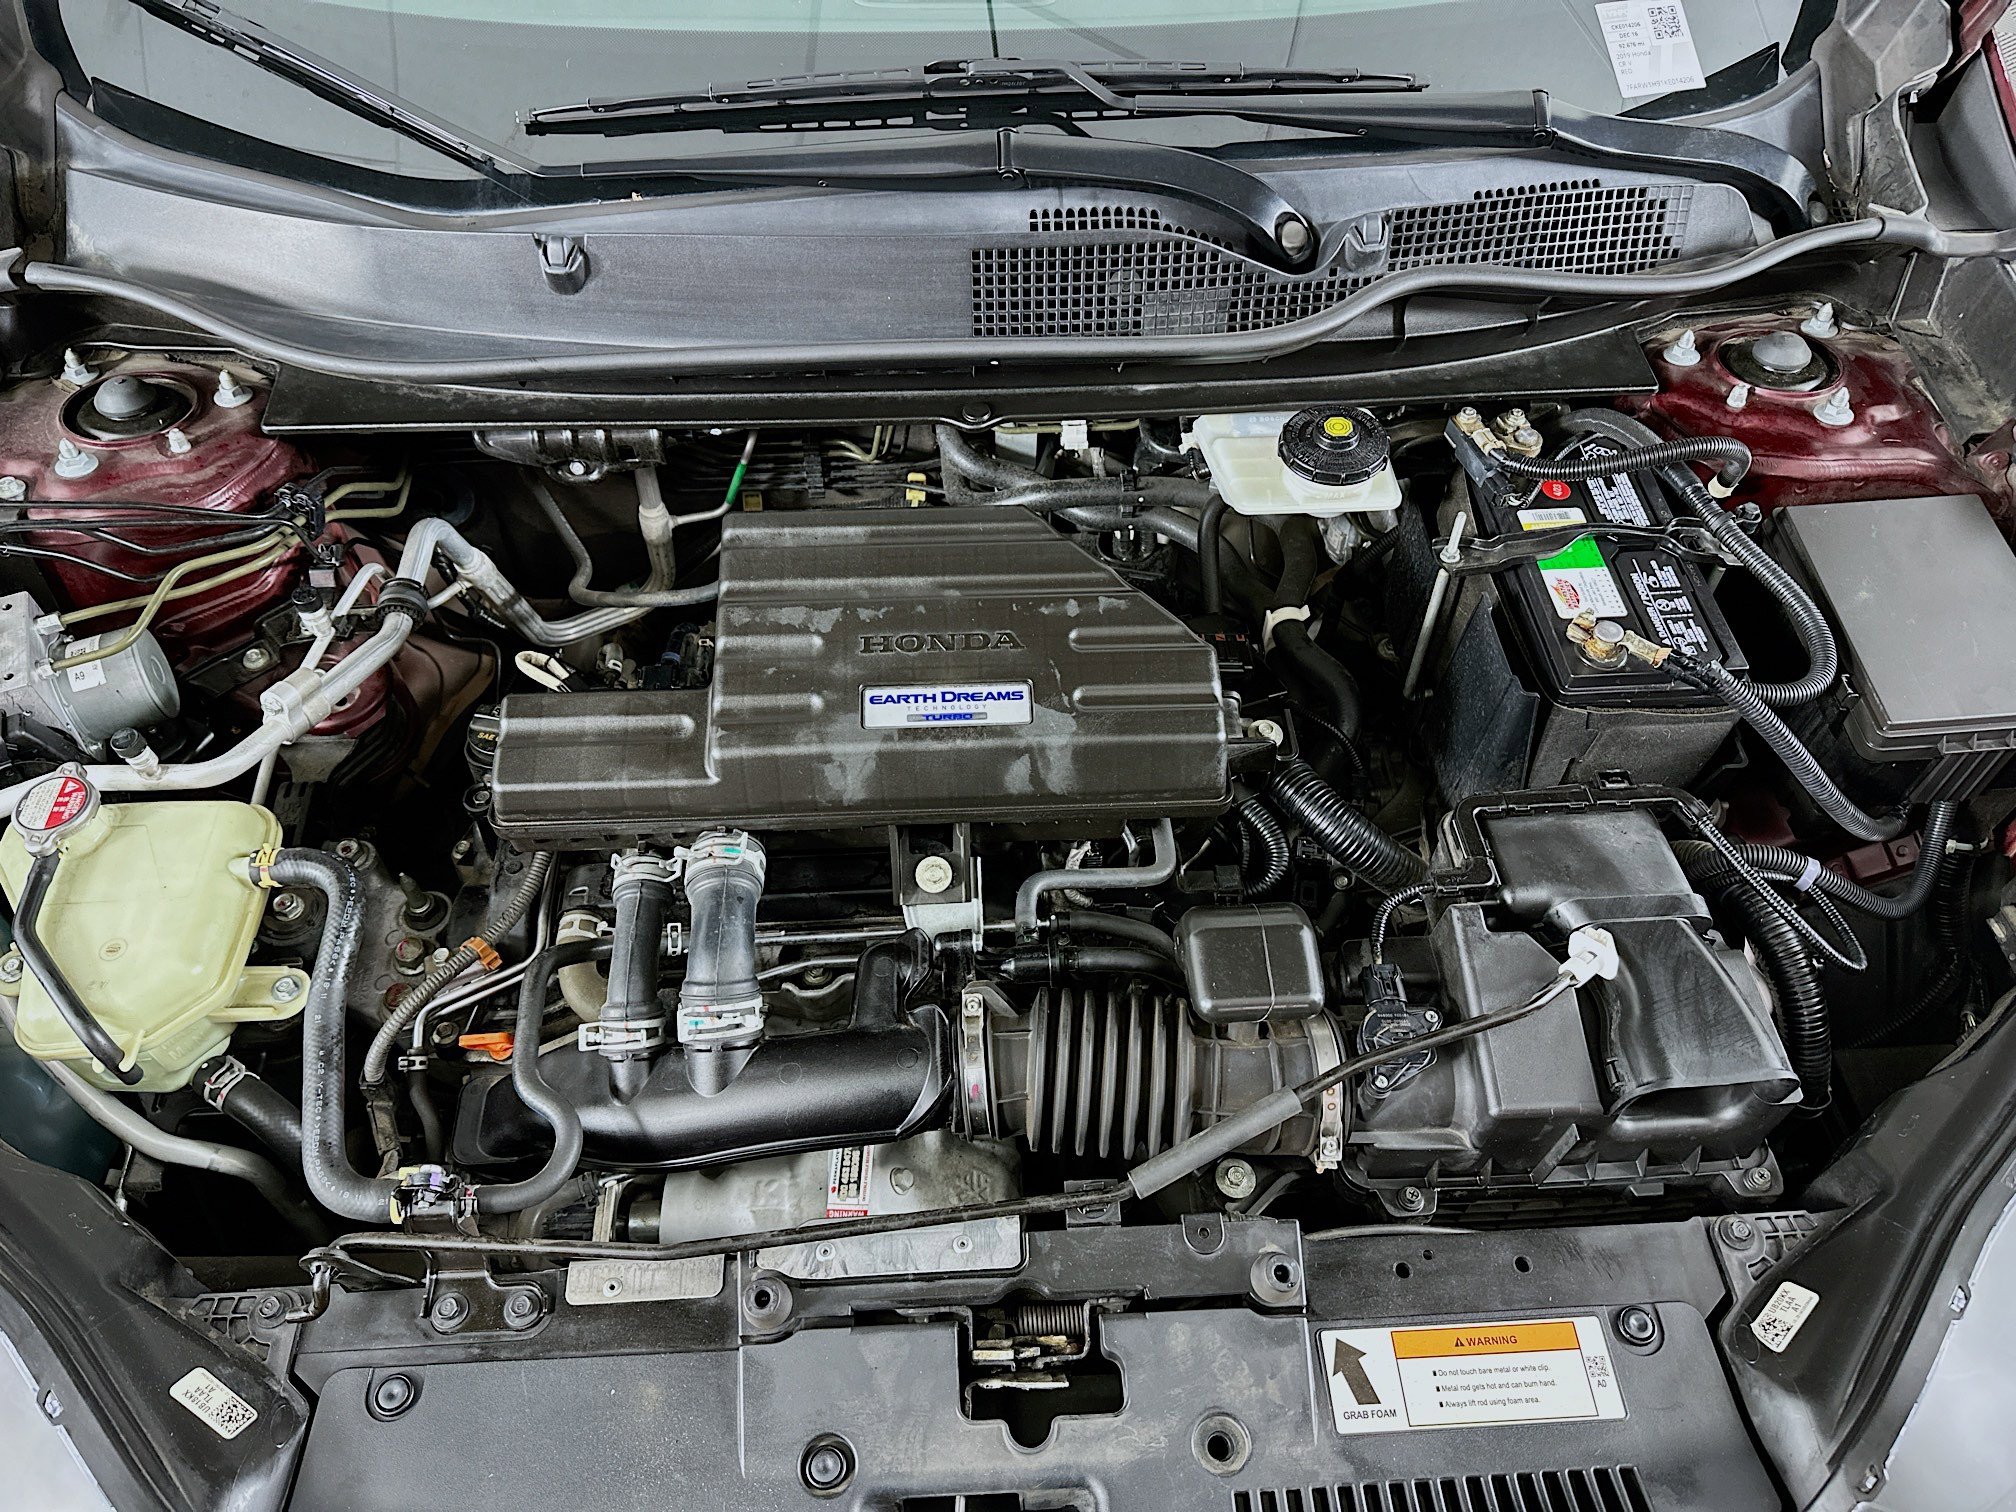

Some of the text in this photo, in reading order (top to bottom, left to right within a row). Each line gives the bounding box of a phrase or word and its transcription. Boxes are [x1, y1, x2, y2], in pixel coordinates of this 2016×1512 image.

[859, 631, 1026, 653] HONDA
[74, 671, 85, 681] A9
[869, 690, 1024, 705] EARTH DREAMS
[907, 704, 988, 712] TECHNOLOGY
[922, 713, 973, 721] TURBO
[477, 732, 495, 741] SAE
[1781, 1296, 1796, 1313] TLAA
[1466, 1335, 1518, 1347] WARNING
[1478, 1367, 1493, 1375] bare
[1494, 1366, 1511, 1374] metal
[1520, 1364, 1537, 1372] white
[1472, 1383, 1486, 1392] gets
[1486, 1382, 1497, 1390] hot
[1539, 1379, 1557, 1387] hand.
[194, 1386, 213, 1404] TLAA
[1445, 1400, 1468, 1408] Always
[1489, 1399, 1507, 1407] using
[1525, 1396, 1541, 1404] area.
[1343, 1408, 1397, 1420] GRAB FOAM
